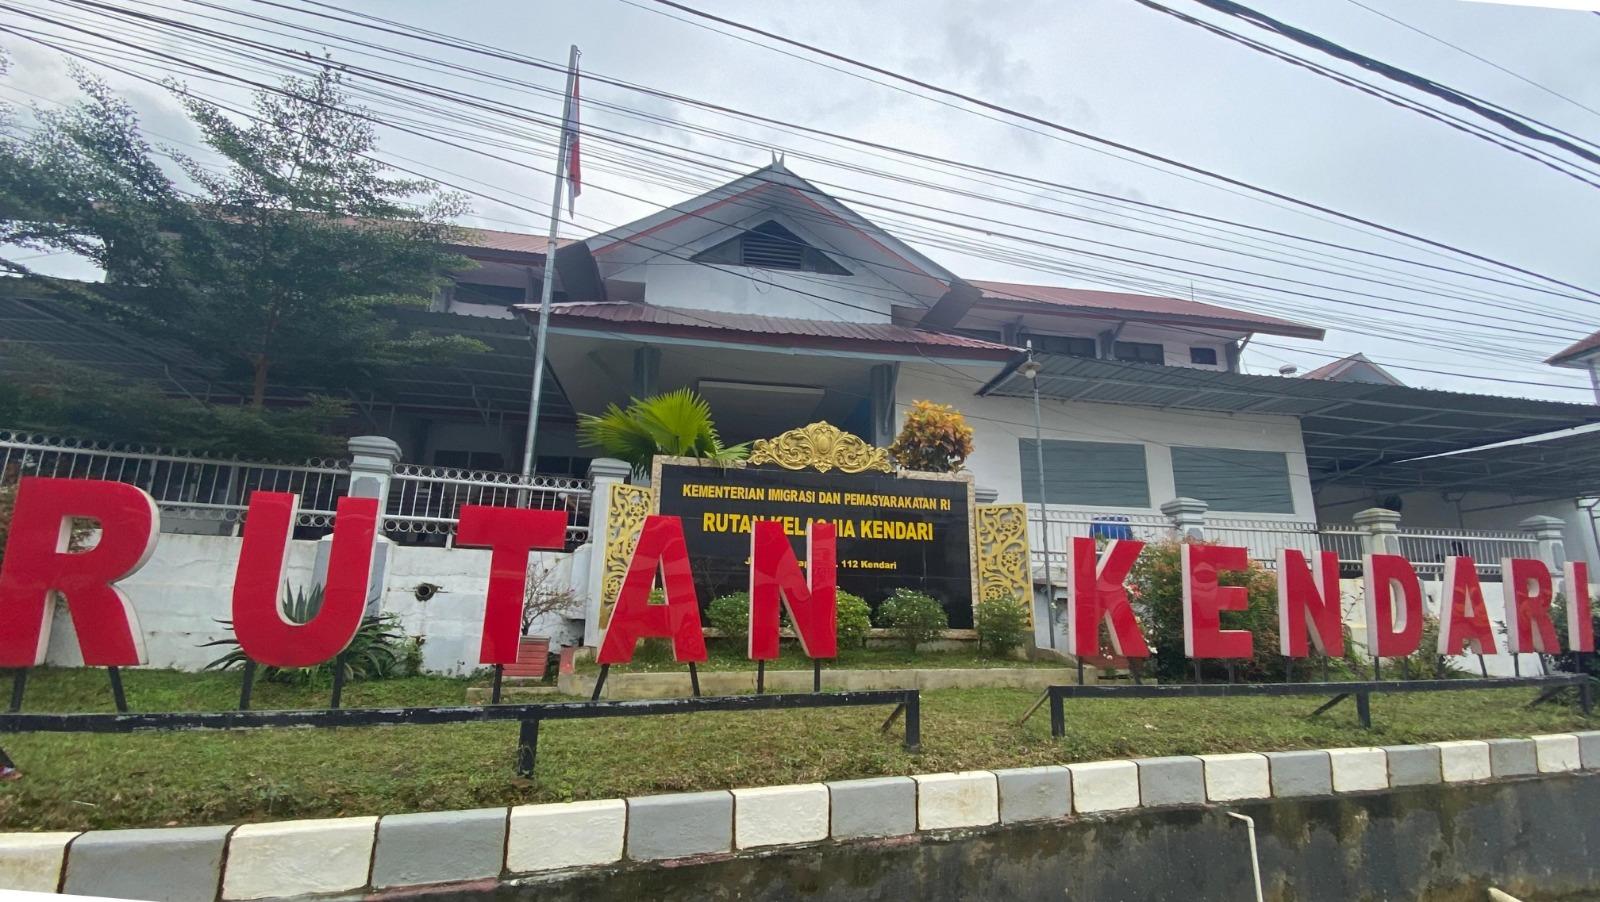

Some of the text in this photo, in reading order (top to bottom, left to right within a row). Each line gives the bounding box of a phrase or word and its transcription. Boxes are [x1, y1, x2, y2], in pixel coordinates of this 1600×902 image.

[682, 484, 951, 511] KEMENTERIAN IMIGRASI DAN PEMASYARAKATAN RI
[703, 512, 765, 533] RUTA
[860, 519, 934, 541] KENDARI
[0, 476, 1595, 669] RUTAN KENDARI
[841, 559, 897, 570] 112 Kendari
